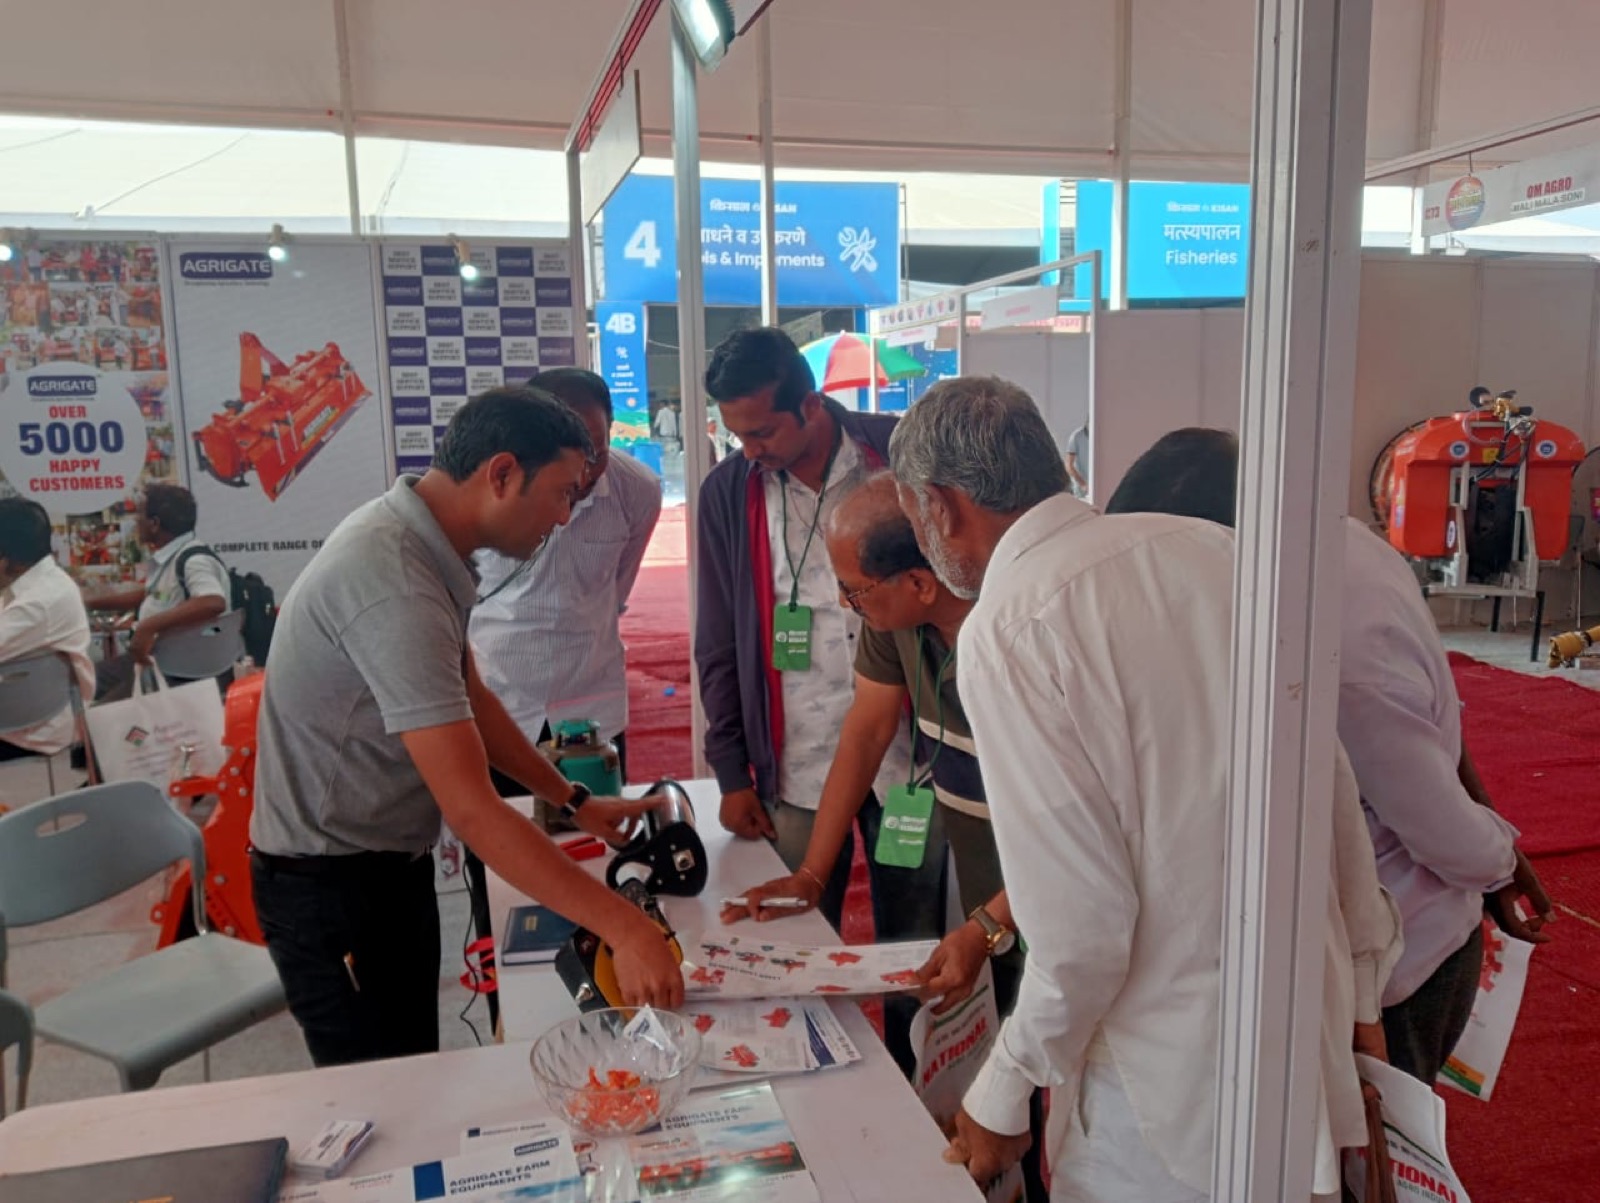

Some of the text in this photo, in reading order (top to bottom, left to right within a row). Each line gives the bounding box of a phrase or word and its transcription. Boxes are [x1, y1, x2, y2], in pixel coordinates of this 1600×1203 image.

[1526, 176, 1572, 198] OM AGRO
[1163, 223, 1241, 241] मत्स्यपालन
[624, 219, 662, 268] 4
[183, 259, 271, 273] AGRIGATE
[720, 252, 731, 265] &
[1165, 249, 1238, 266] Fisheries
[605, 312, 636, 334] 4B
[30, 380, 95, 392] AGRIGATE
[49, 405, 87, 419] OVER
[19, 421, 124, 456] 5000
[49, 459, 100, 473] HAPPY
[29, 475, 125, 492] CUSTOMERS
[213, 541, 269, 553] COMPLETE
[272, 539, 308, 551] RANGE
[451, 1160, 551, 1187] AGRIGATE FARM
[451, 1173, 532, 1195] EQUIPMENTS
